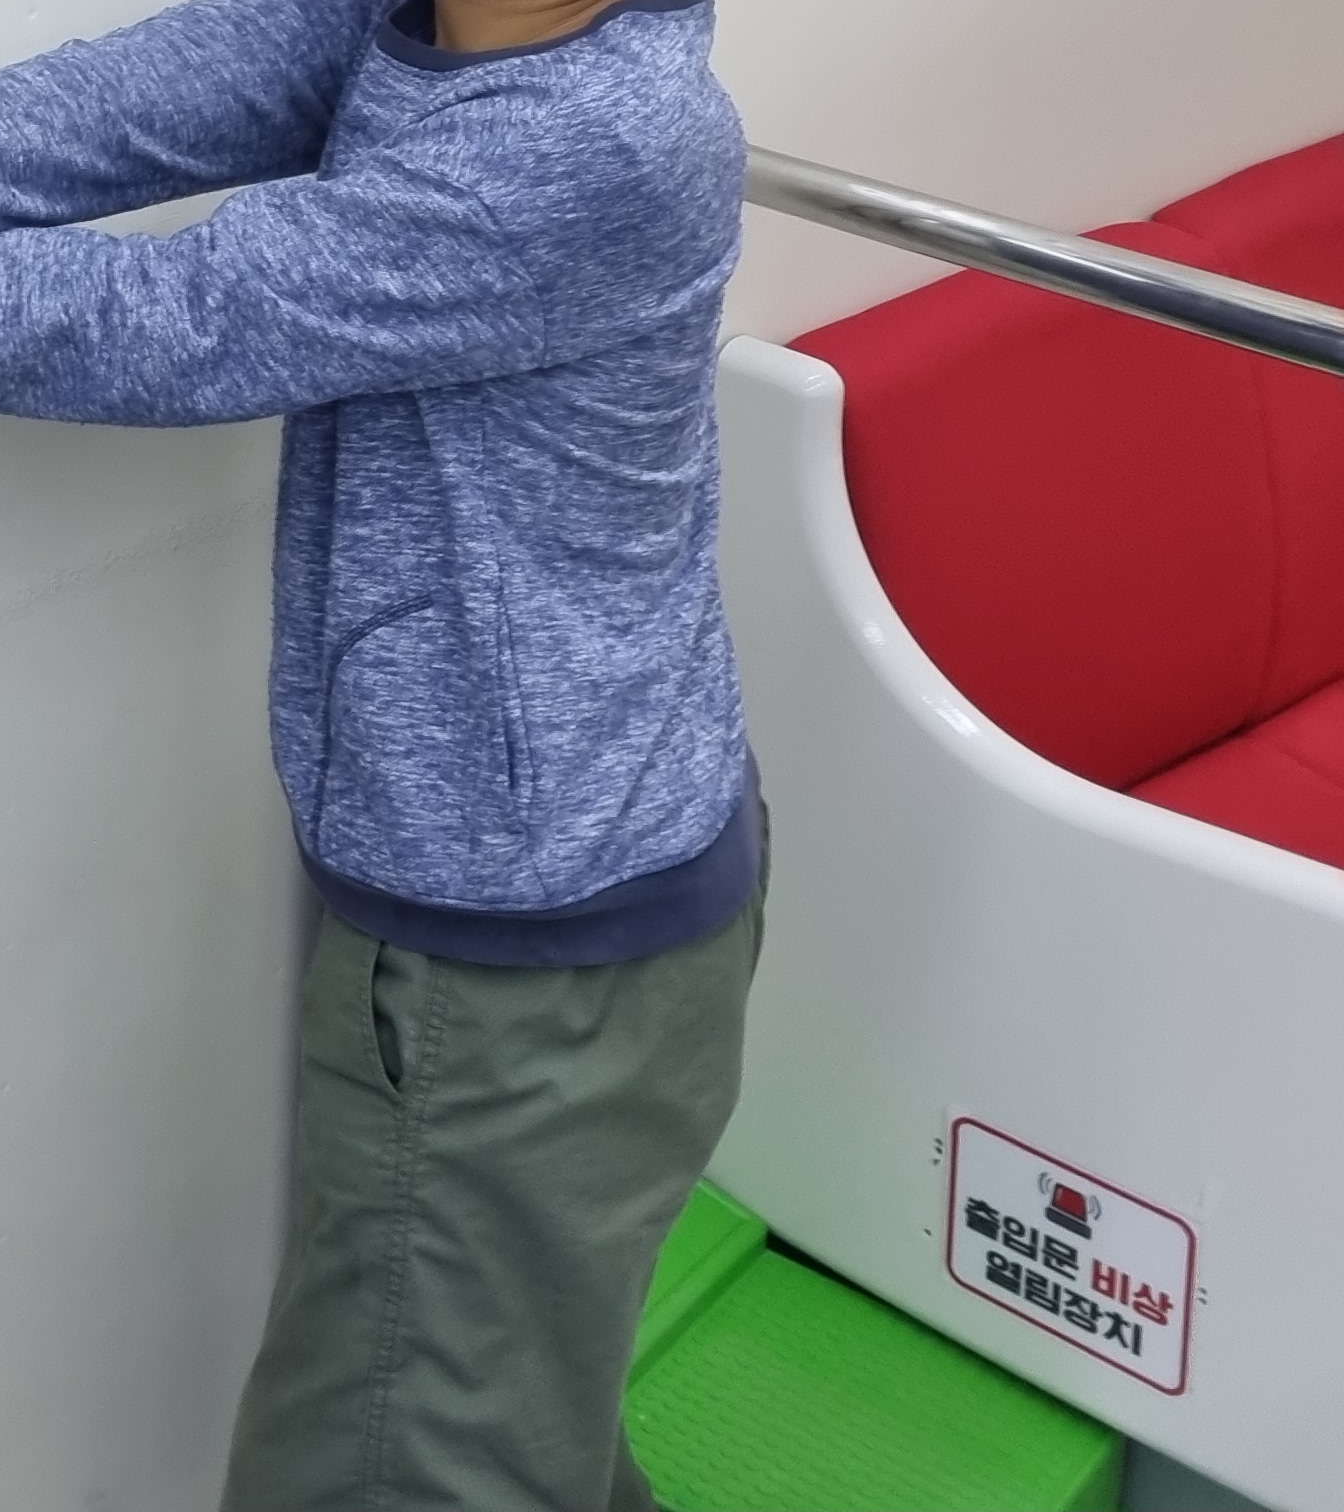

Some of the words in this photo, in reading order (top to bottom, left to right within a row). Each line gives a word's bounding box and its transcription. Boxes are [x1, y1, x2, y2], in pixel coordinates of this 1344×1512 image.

[964, 1196, 1080, 1281] 출입문
[1090, 1257, 1174, 1326] 비상
[985, 1249, 1143, 1357] 열림장치
